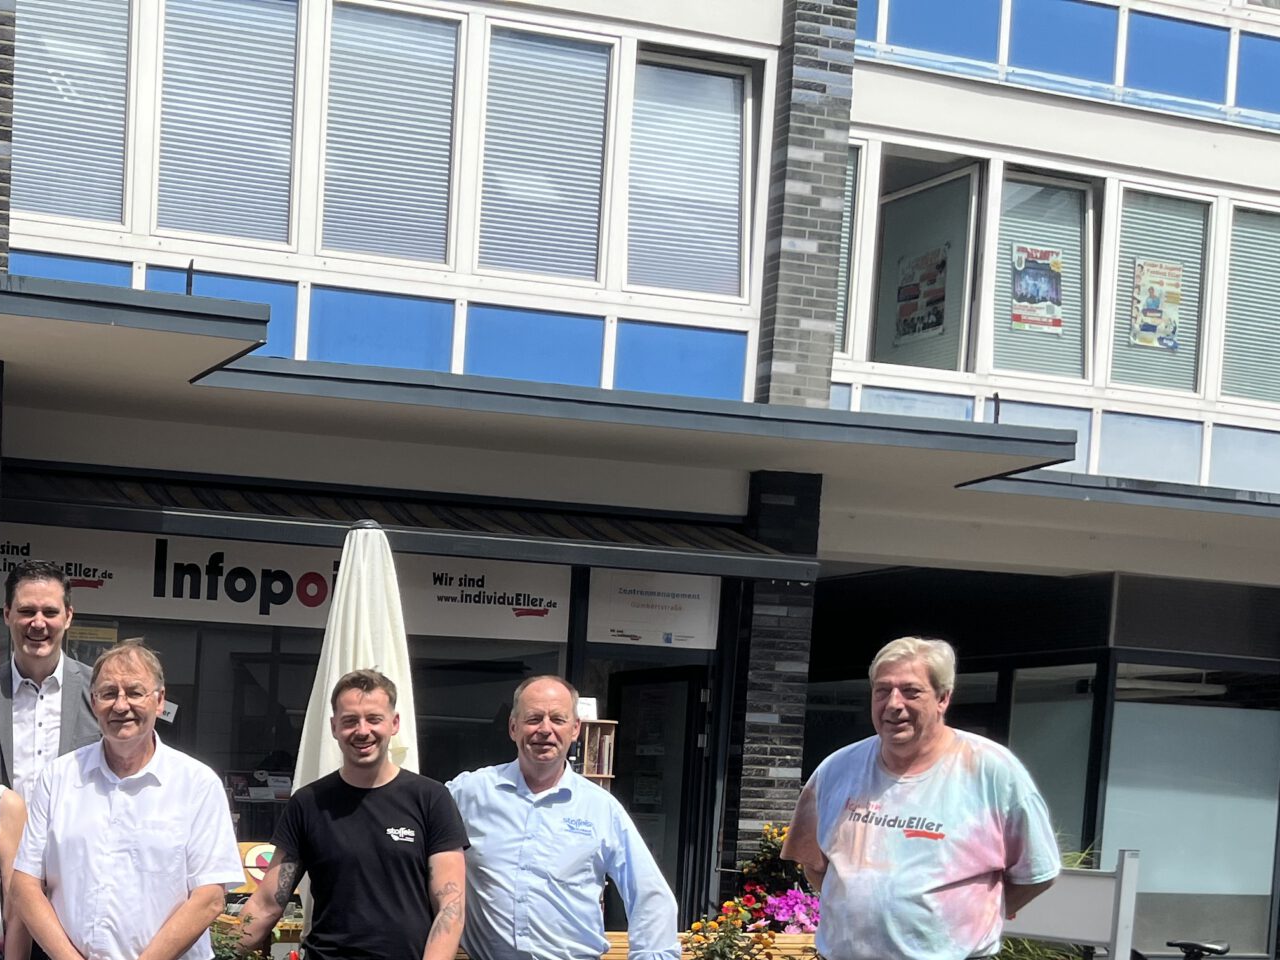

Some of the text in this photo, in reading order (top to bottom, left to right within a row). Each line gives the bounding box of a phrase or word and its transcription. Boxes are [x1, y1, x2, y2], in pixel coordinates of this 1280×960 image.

[0, 541, 30, 556] sind
[432, 571, 485, 589] Wir sind
[437, 590, 557, 609] www.individuEller.de
[848, 810, 943, 832] individuEller
